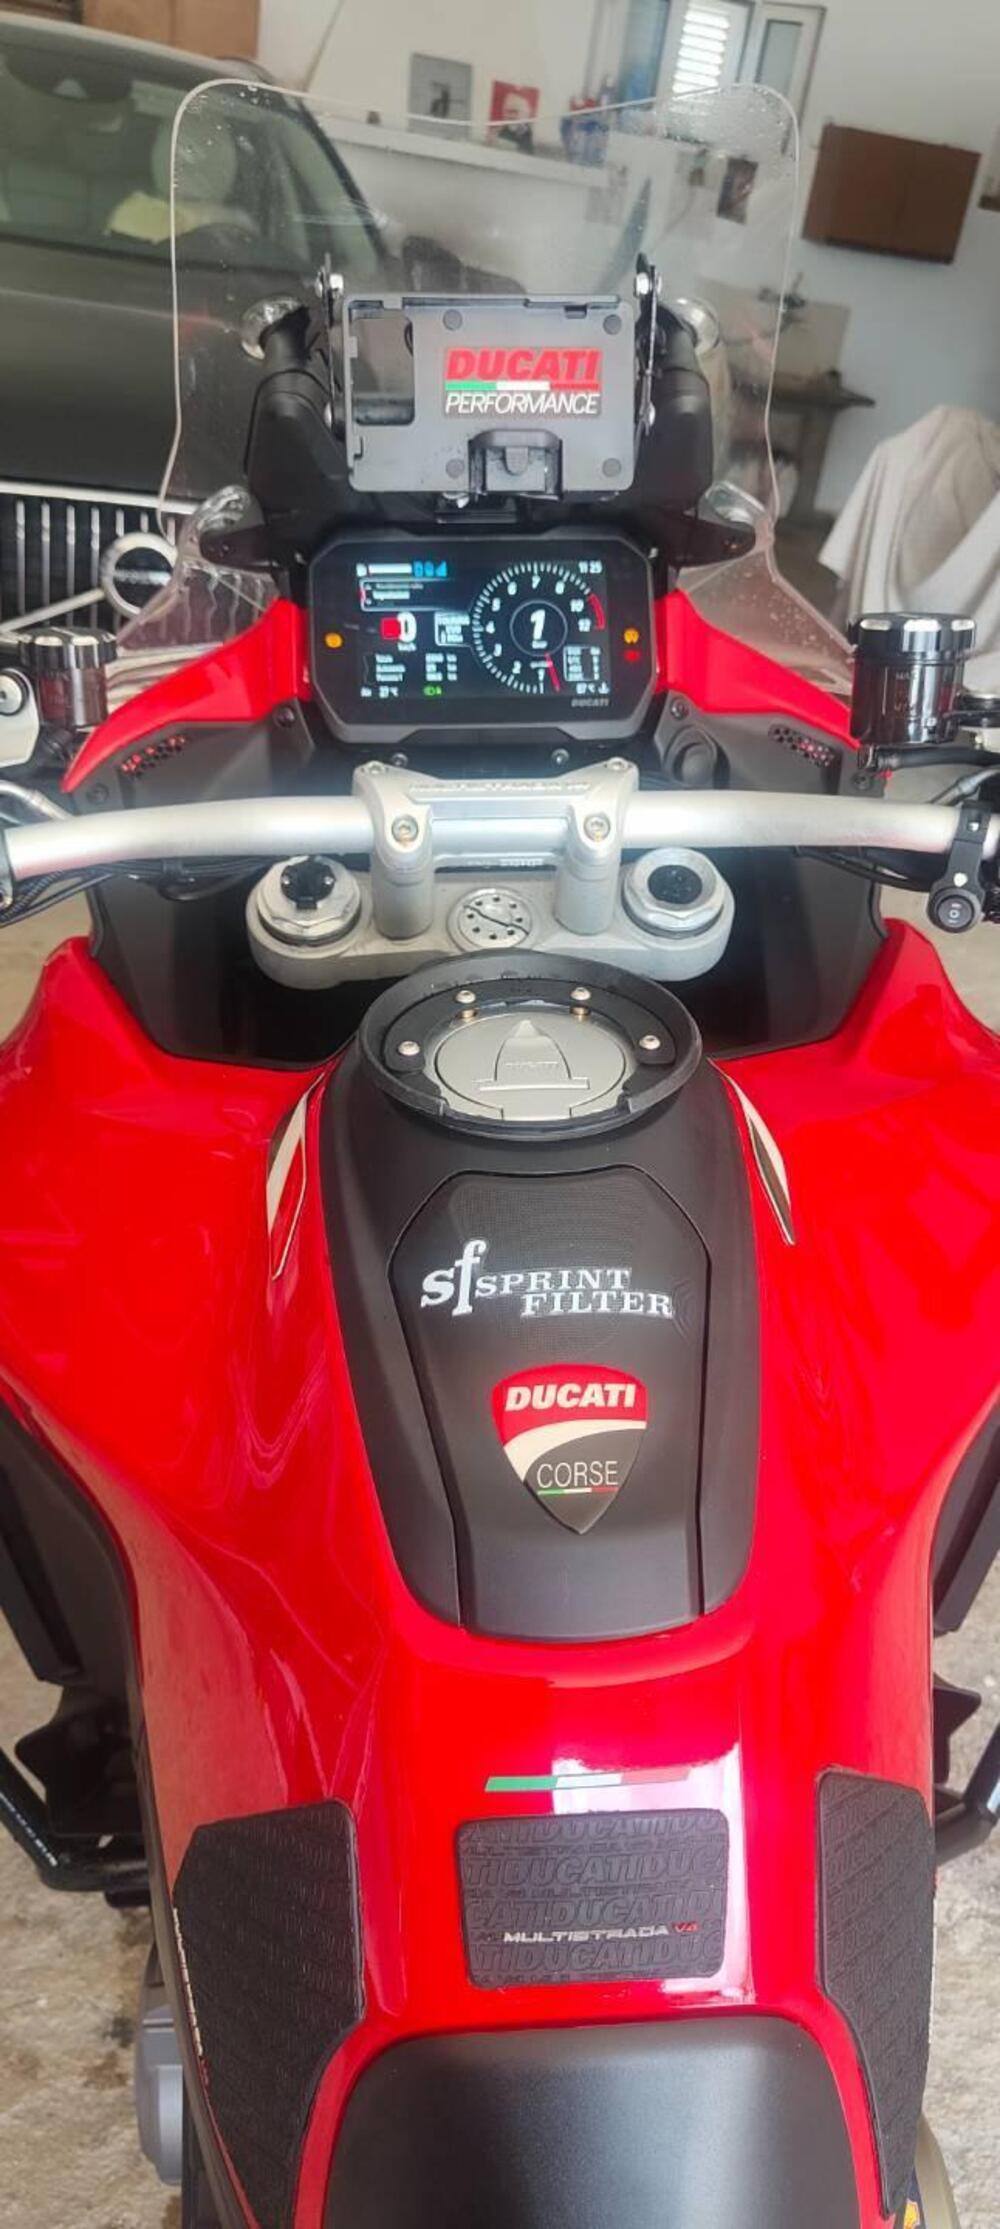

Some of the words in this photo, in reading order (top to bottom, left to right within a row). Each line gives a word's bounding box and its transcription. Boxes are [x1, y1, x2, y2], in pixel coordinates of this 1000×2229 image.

[446, 349, 601, 380] DUCATI
[445, 392, 600, 414] PERFORMANCE
[532, 575, 540, 589] 7
[570, 599, 584, 612] 10
[397, 612, 417, 642] 0
[486, 621, 495, 634] 4
[531, 609, 546, 640] 1
[512, 661, 521, 674] 2
[571, 698, 609, 707] DUCATI
[475, 1267, 632, 1298] SPRINT
[520, 1291, 674, 1319] FILTER
[505, 1383, 637, 1411] DUCATI
[536, 1460, 618, 1488] CORSE
[503, 1925, 669, 1943] MULTISTRADA
[671, 1921, 698, 1934] V4
